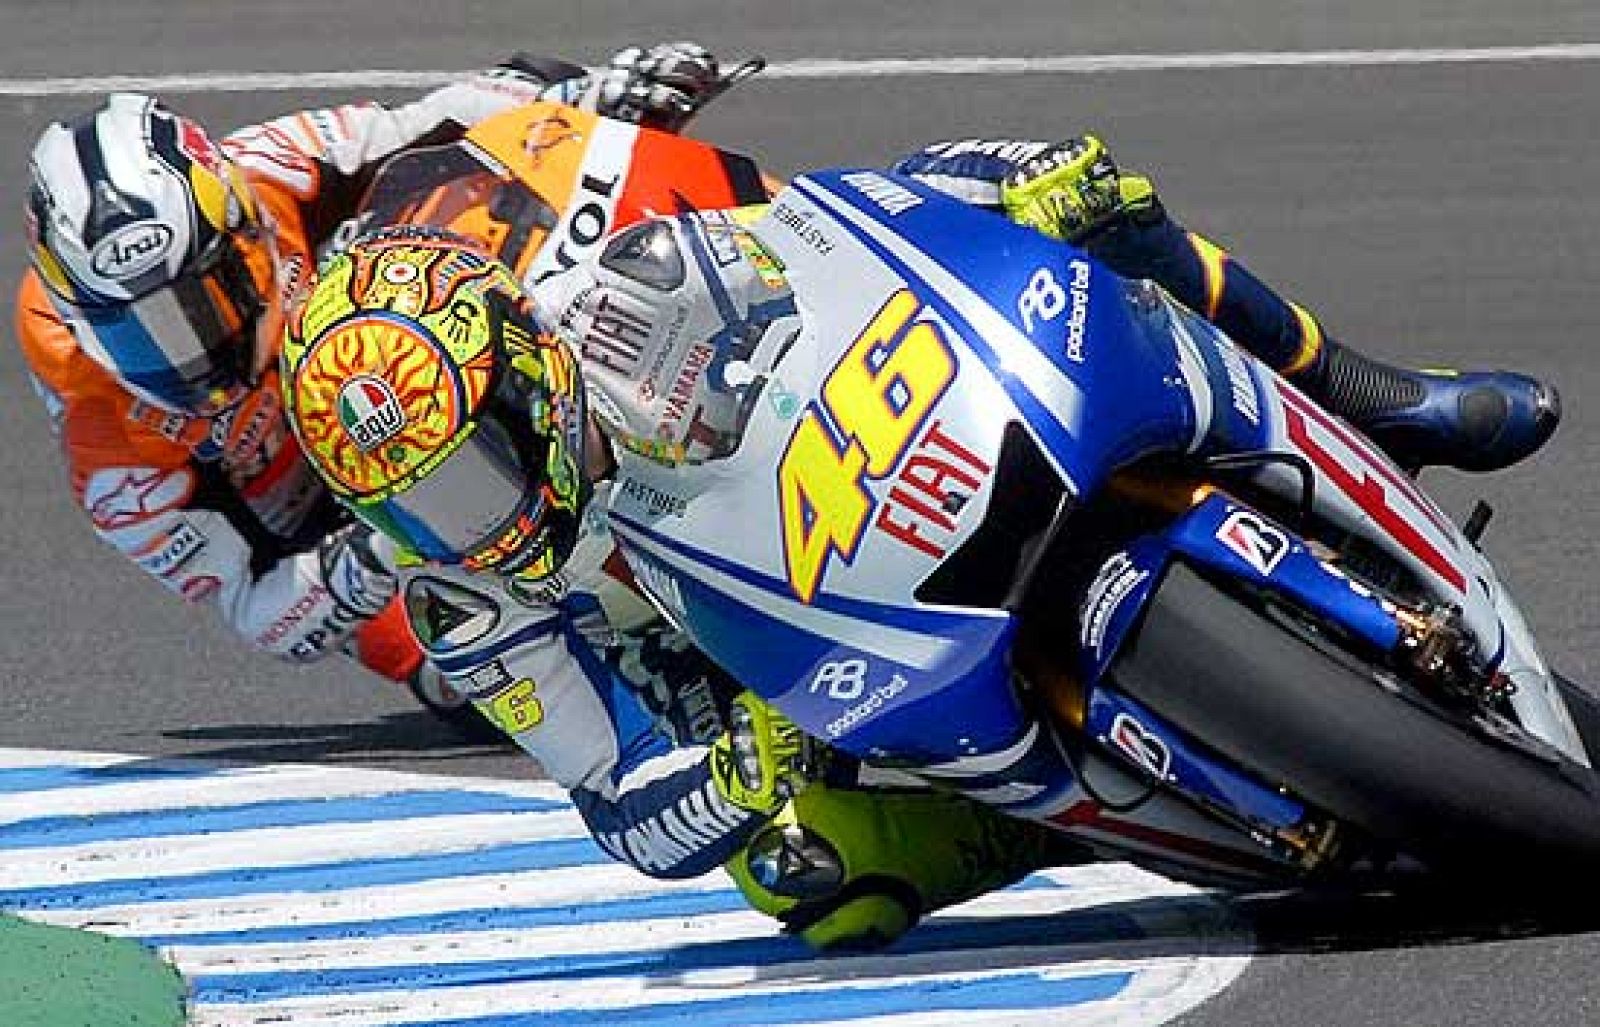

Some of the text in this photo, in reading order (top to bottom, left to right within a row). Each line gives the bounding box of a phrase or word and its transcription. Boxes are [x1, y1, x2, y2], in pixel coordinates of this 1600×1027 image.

[110, 229, 164, 268] Arai
[778, 288, 959, 604] 46
[875, 418, 992, 560] FIAT
